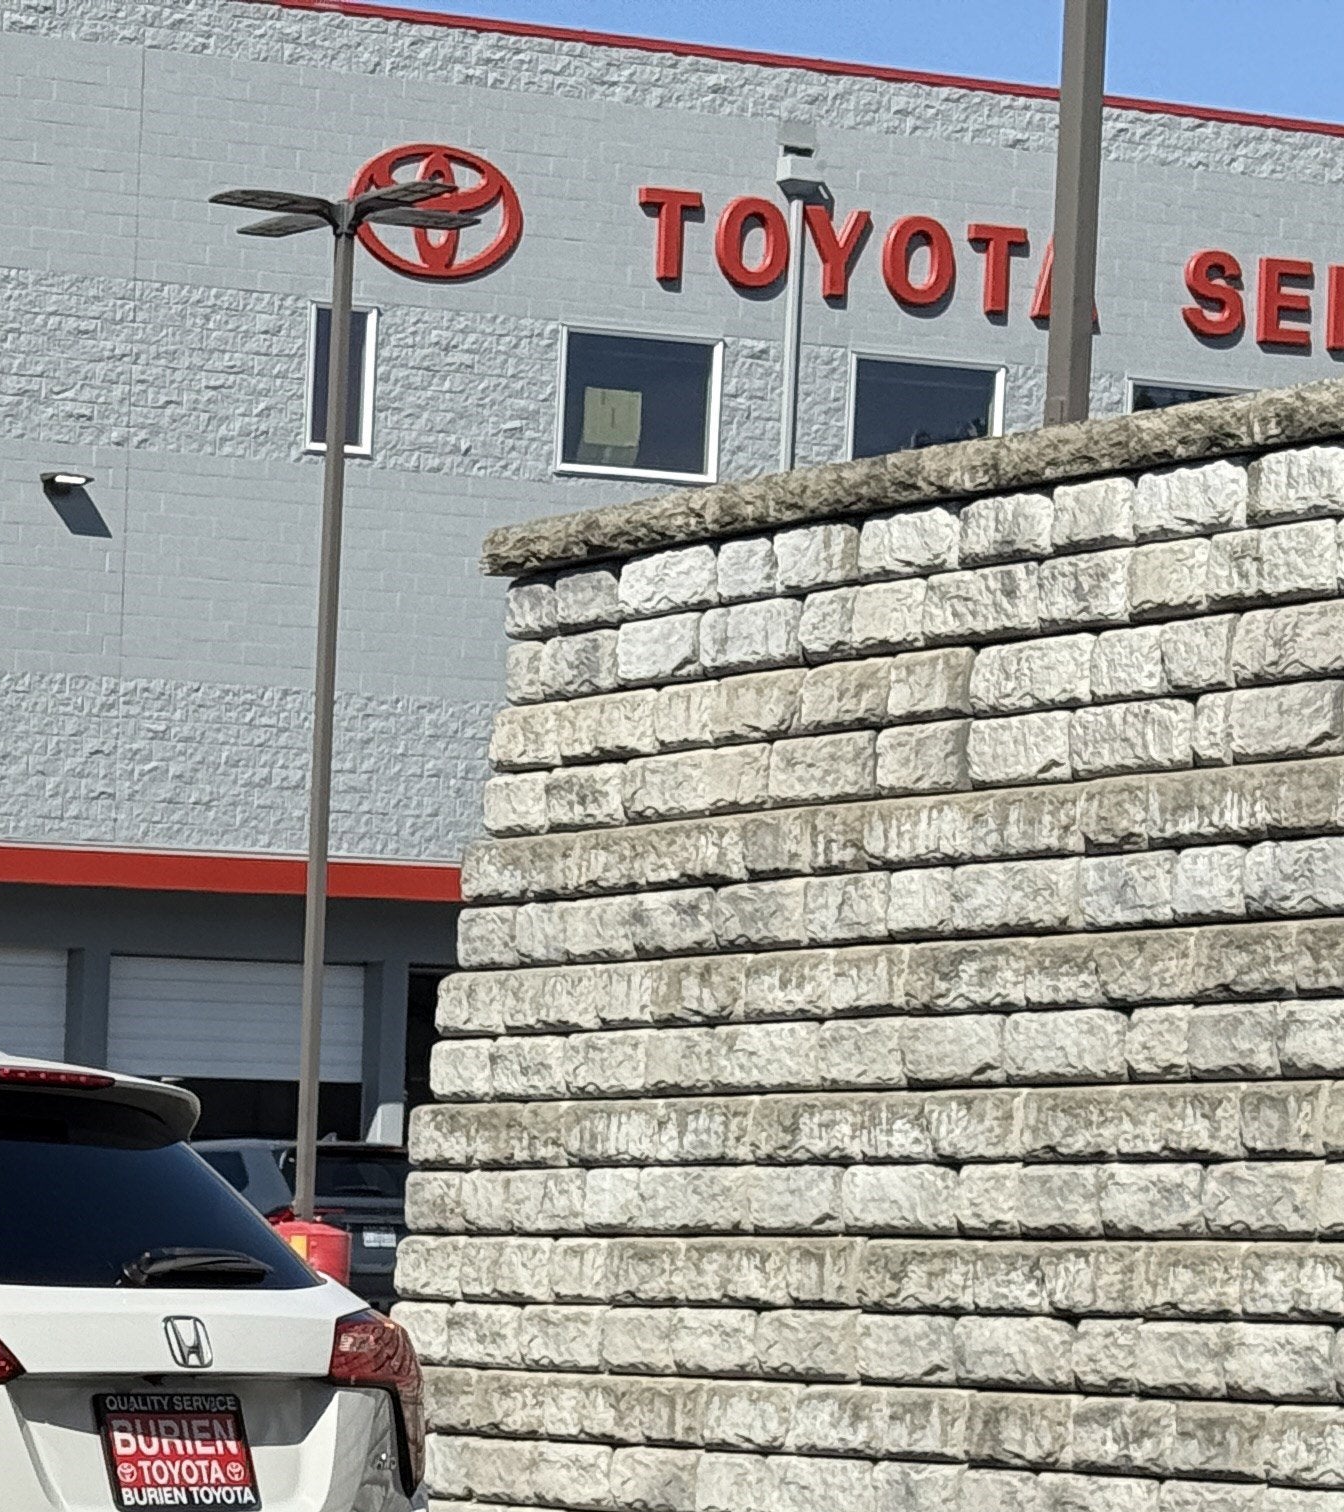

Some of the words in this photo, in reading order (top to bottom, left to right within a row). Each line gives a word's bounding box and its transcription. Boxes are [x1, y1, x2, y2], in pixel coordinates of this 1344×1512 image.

[638, 186, 1099, 322] TOYOT
[105, 1395, 170, 1412] QUALITY
[173, 1395, 237, 1412] SERVICE
[111, 1417, 240, 1456] BURIEN
[138, 1459, 226, 1485] TOYOTA
[121, 1487, 188, 1506] BURIEN
[191, 1486, 256, 1504] TOYOTA
